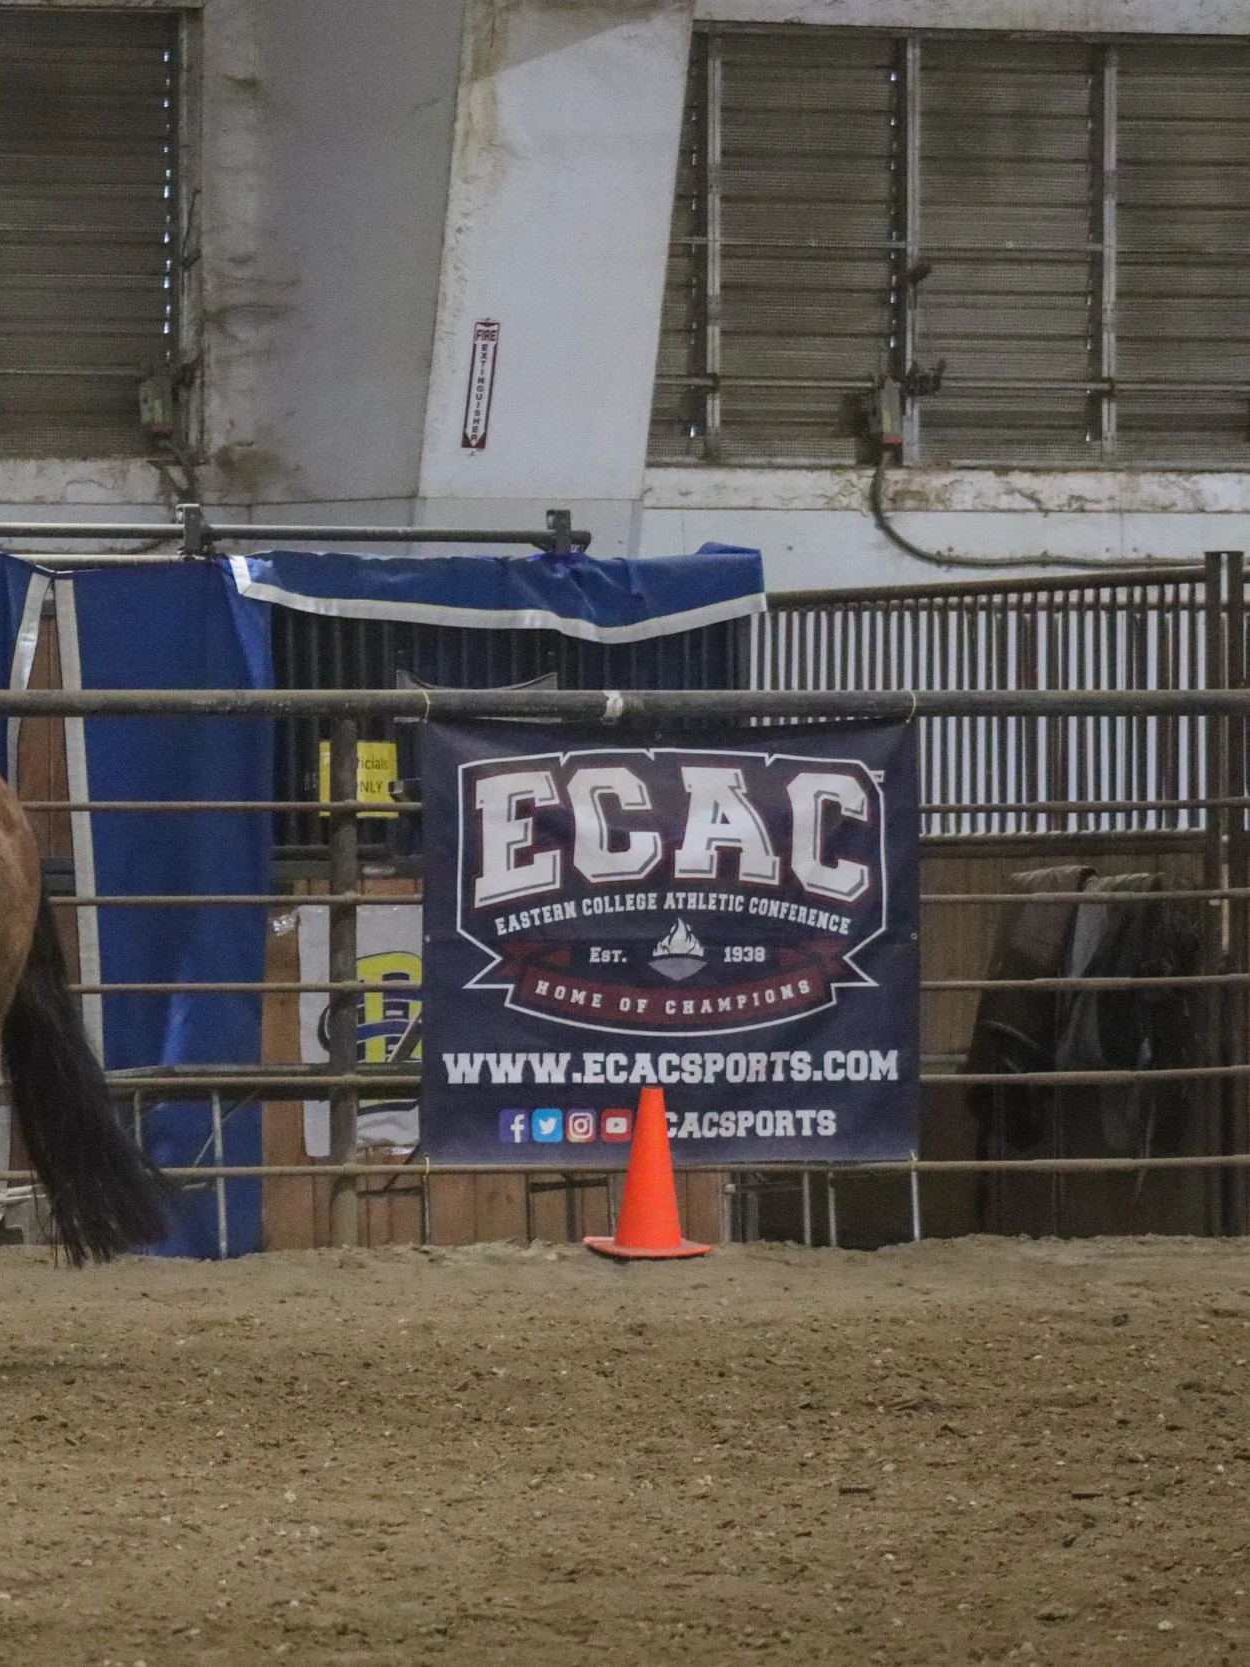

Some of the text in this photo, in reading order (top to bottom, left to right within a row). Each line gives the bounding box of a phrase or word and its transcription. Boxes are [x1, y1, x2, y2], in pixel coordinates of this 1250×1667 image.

[476, 329, 497, 342] FIRE
[471, 343, 489, 441] EXTINGUISHER
[360, 755, 388, 770] icials
[360, 780, 383, 794] NLY
[475, 766, 870, 909] ECAC
[494, 891, 852, 936] EASTERN COLLEGE ATHLETIC CONFERENCE
[723, 946, 766, 963] 1938
[534, 979, 811, 1015] HOME OF CHAMPIONS
[442, 1050, 899, 1085] WWW.ECACSPORTS.COM
[664, 1109, 837, 1139] CACSPORTS
